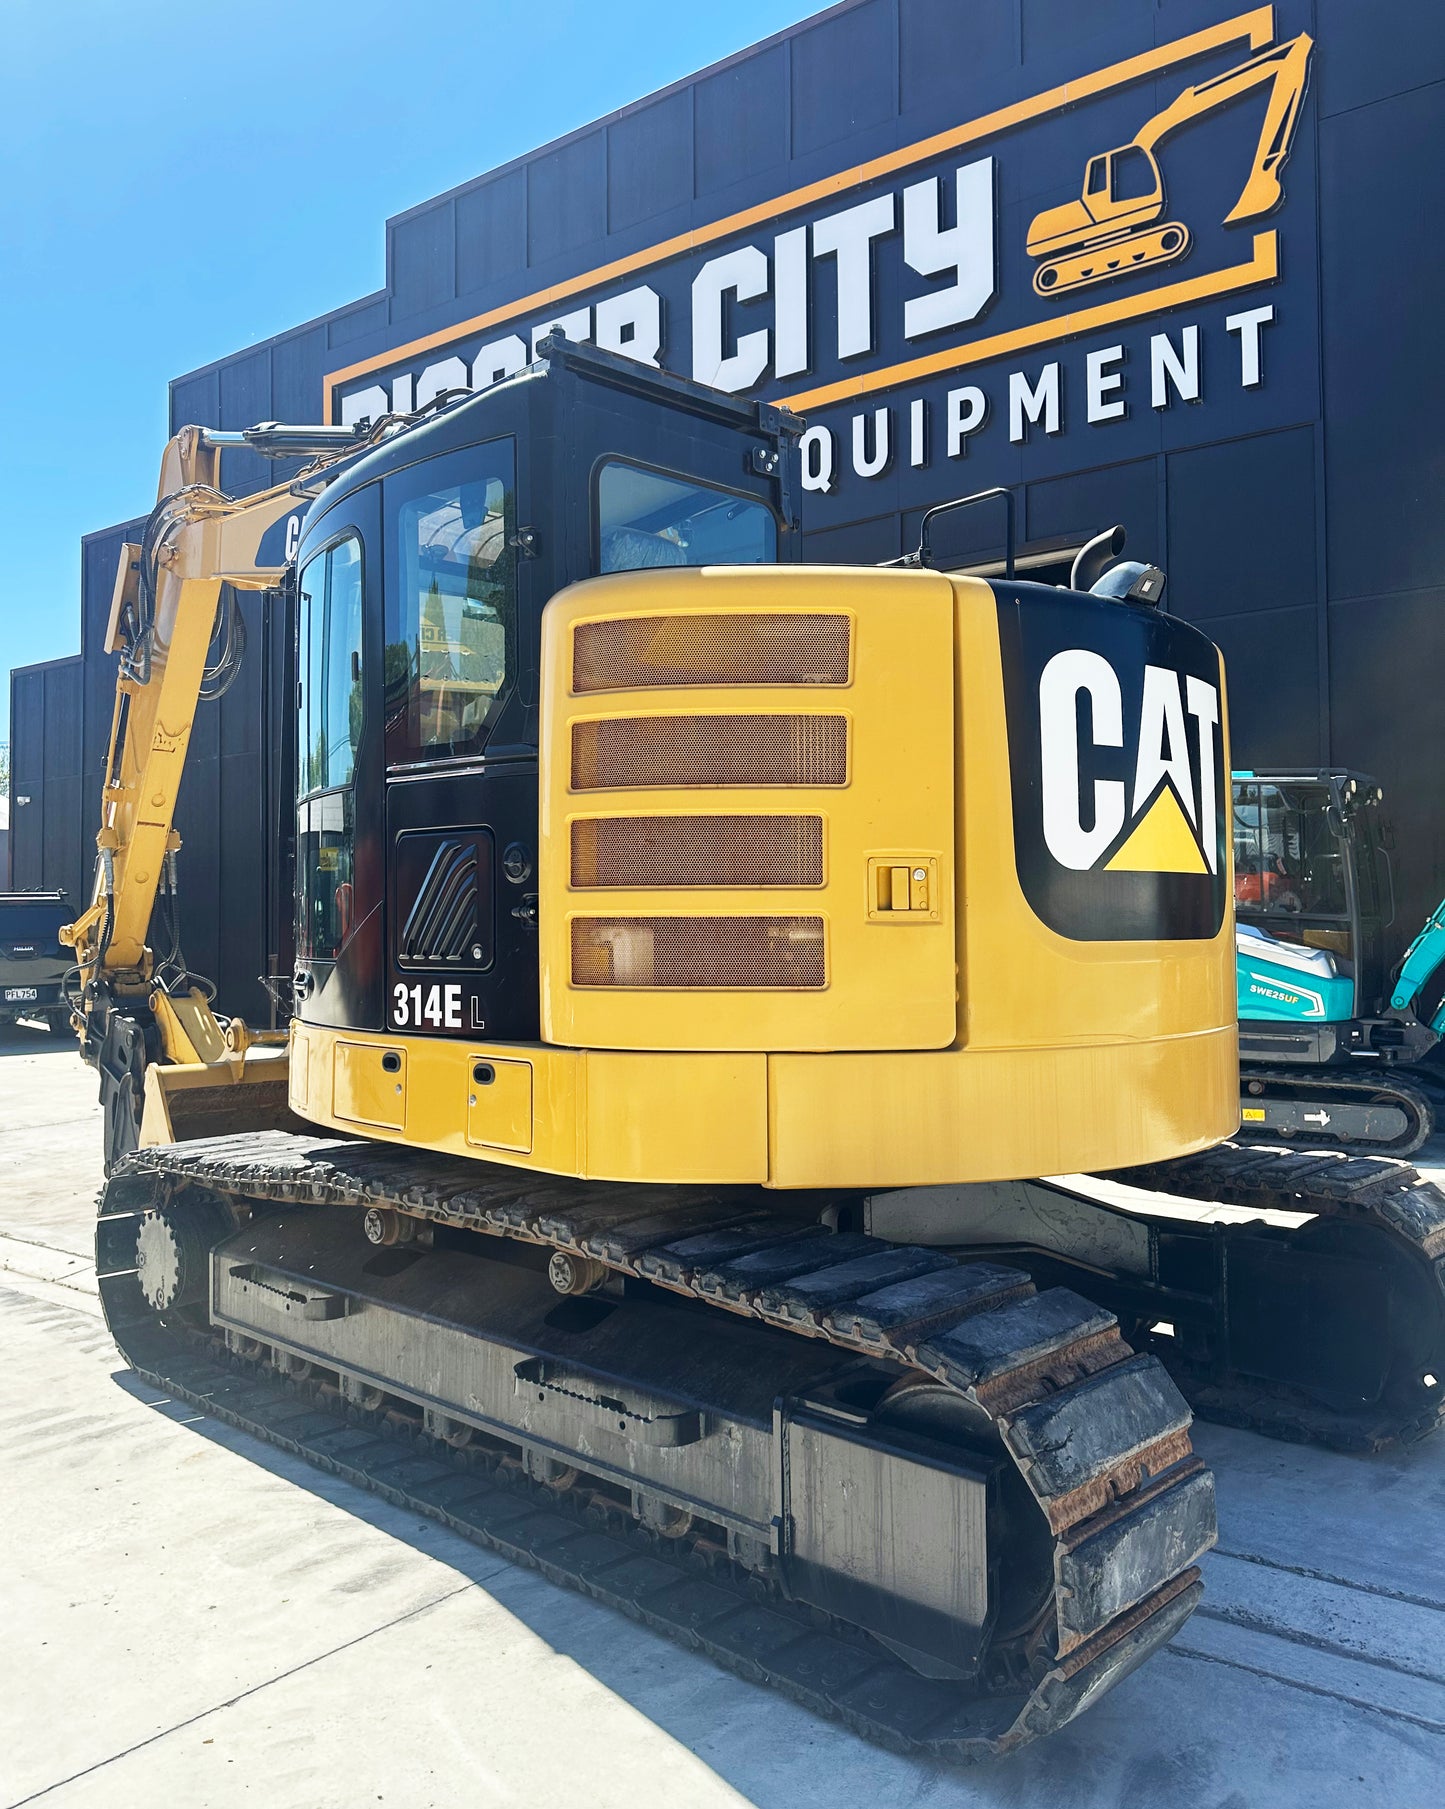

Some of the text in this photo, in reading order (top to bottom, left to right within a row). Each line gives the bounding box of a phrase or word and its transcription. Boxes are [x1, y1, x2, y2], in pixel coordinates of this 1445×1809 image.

[692, 156, 994, 393] CITY
[798, 305, 1274, 493] QUIPMENT
[1039, 649, 1218, 876] CAT
[6, 989, 36, 999] PFL754
[393, 983, 485, 1030] 314E L
[1249, 984, 1300, 1004] SWE25UF
